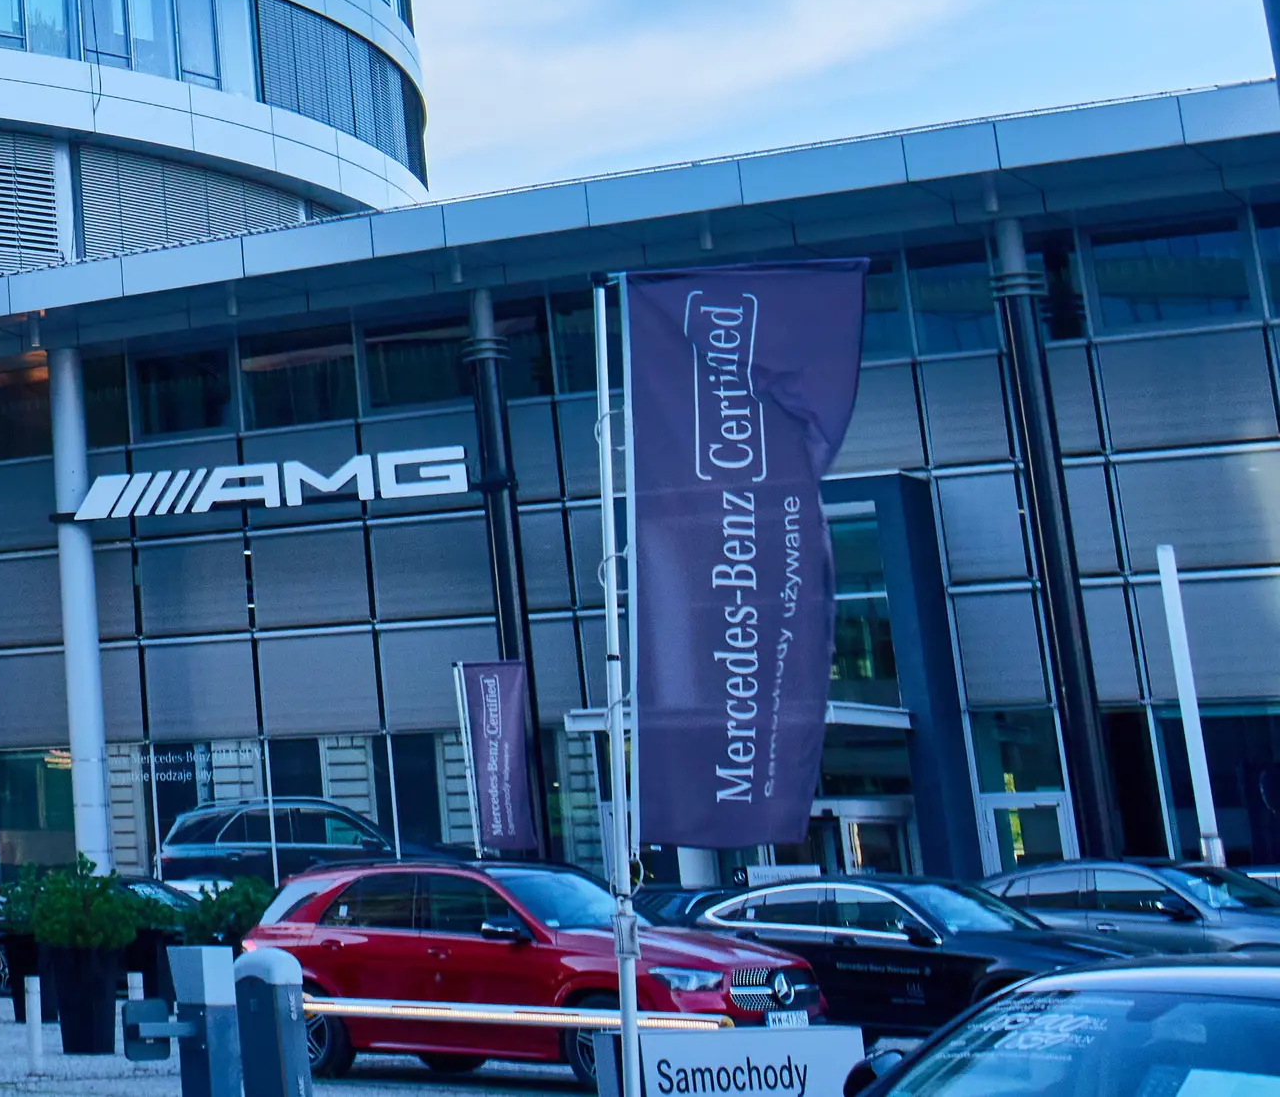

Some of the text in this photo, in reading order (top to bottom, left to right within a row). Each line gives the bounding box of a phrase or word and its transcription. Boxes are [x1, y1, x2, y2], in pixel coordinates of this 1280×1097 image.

[191, 445, 469, 513] AMG
[700, 305, 759, 803] Mercedes-Benz Certified
[779, 495, 801, 619] używane
[156, 769, 192, 783] rodzaje
[483, 678, 503, 836] Mercedes-Benz Certified
[656, 1055, 808, 1097] Samochody
